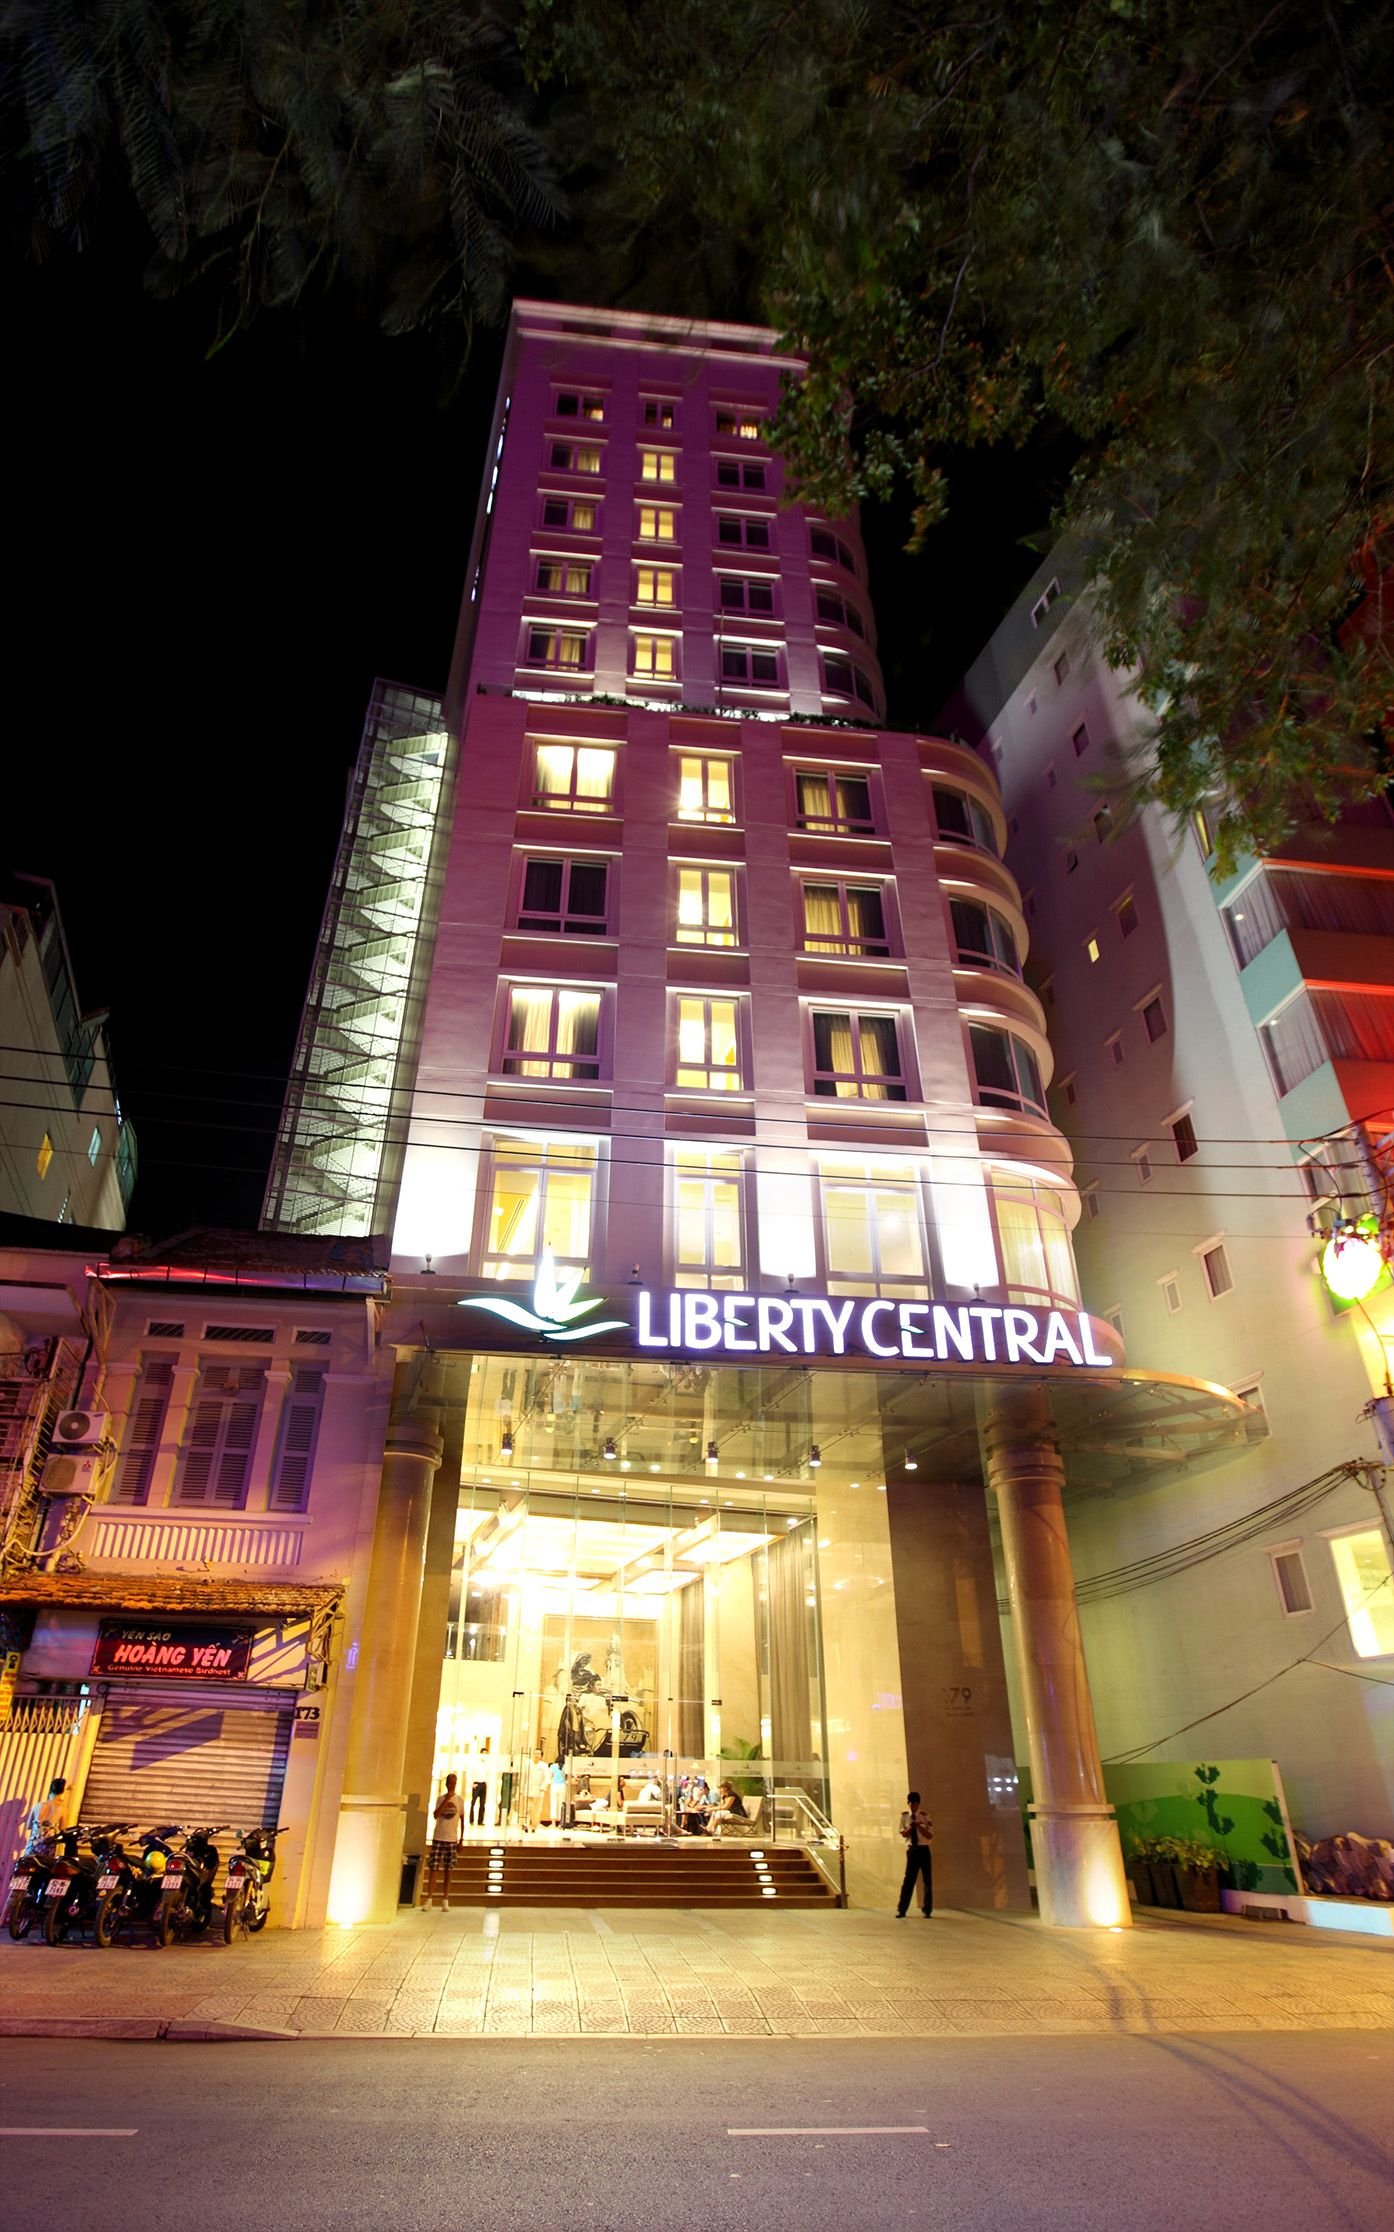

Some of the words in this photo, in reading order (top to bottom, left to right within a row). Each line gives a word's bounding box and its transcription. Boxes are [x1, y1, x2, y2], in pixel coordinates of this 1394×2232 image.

[637, 1291, 855, 1354] LIBERTY
[860, 1300, 1113, 1367] CENTRAL
[114, 1642, 187, 1666] HOÀNG
[191, 1642, 233, 1667] YẾN
[145, 1666, 195, 1674] Vietnamese
[294, 1706, 320, 1720] 173
